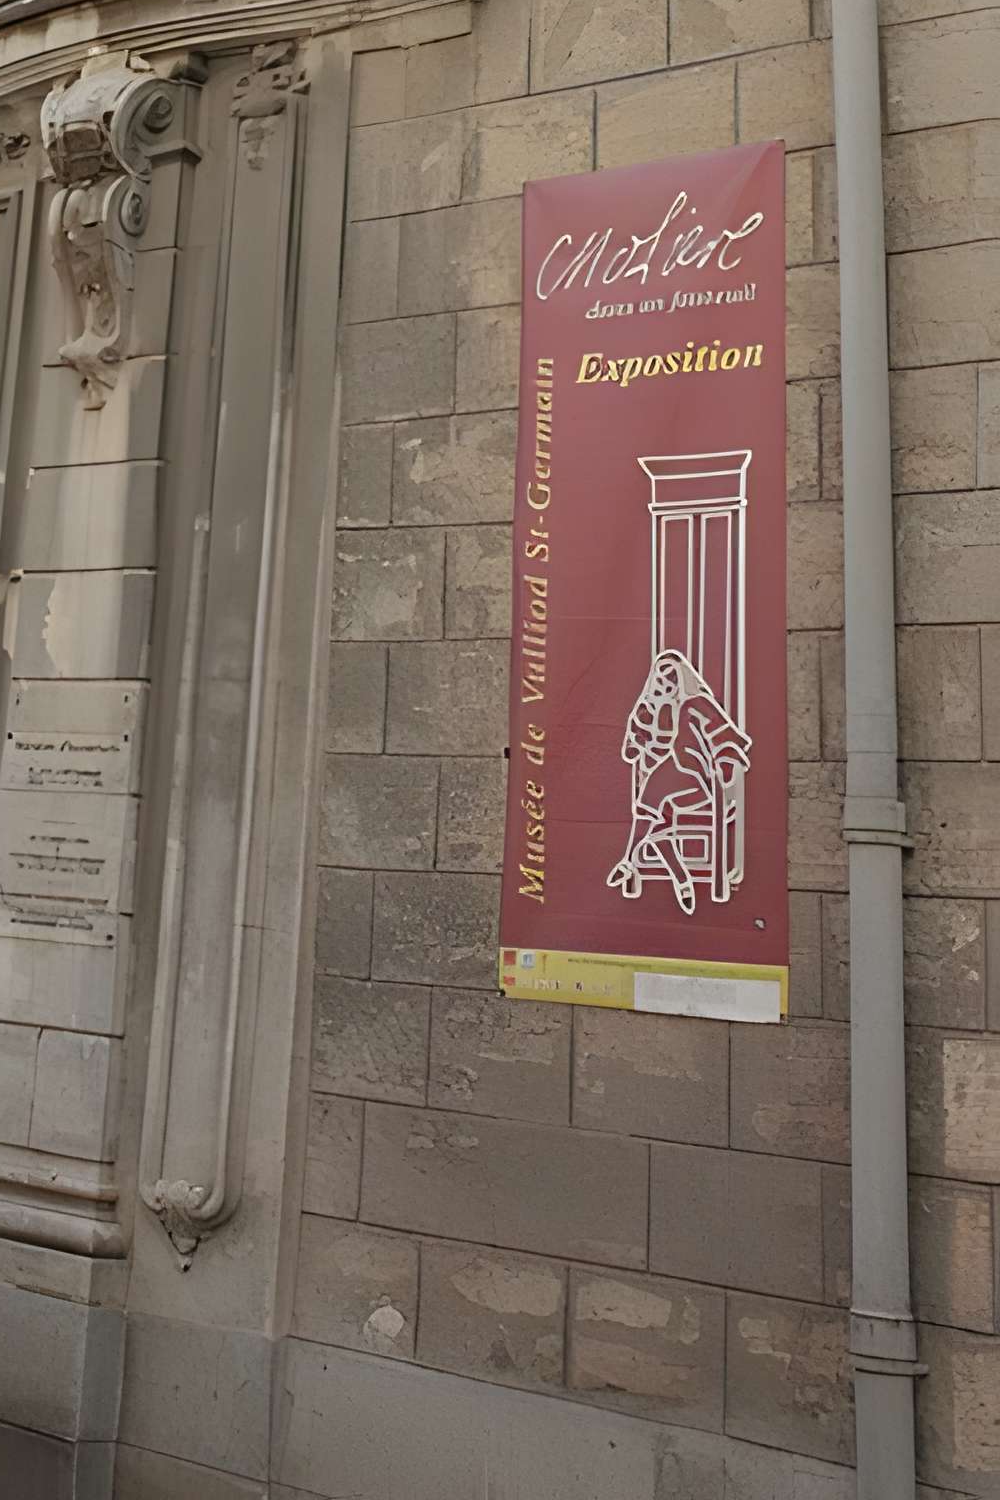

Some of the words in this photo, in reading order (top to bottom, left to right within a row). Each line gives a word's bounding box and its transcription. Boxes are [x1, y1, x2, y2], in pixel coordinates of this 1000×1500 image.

[575, 340, 764, 388] Exposition
[520, 723, 546, 766] de
[518, 779, 545, 904] Musée
